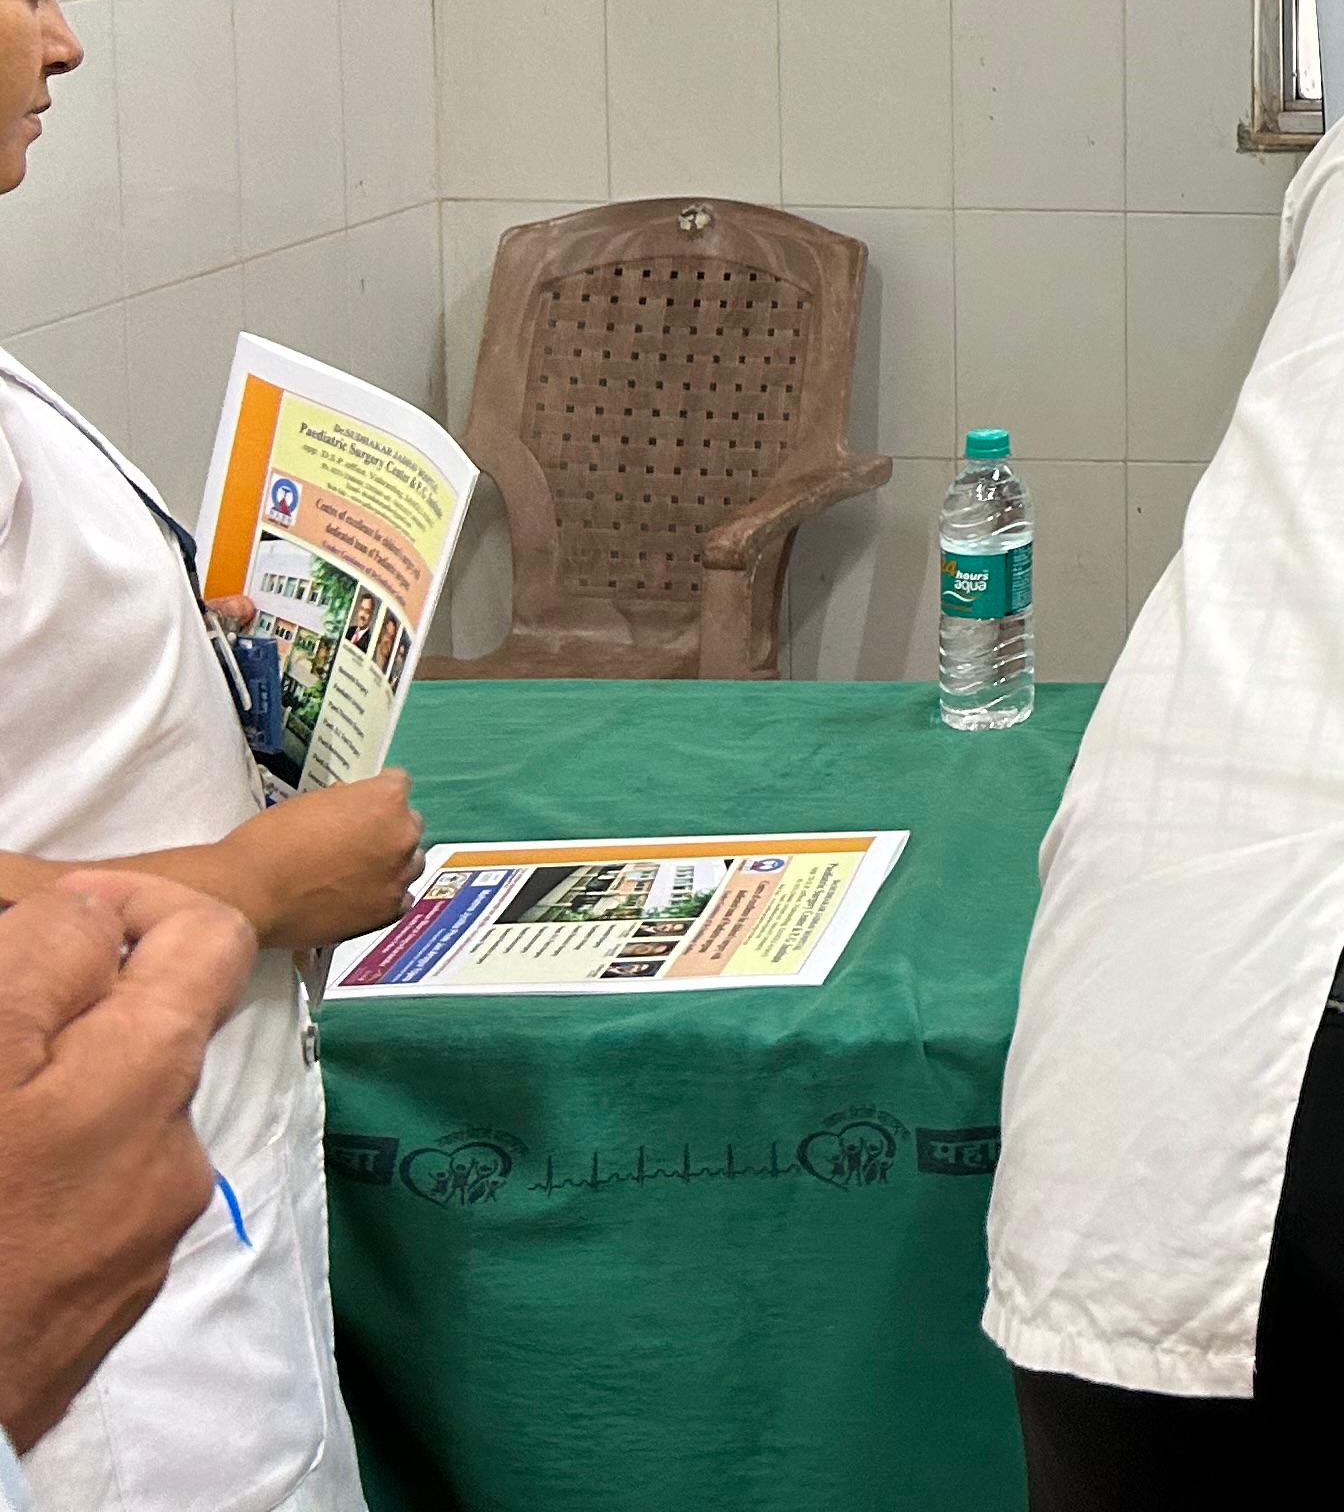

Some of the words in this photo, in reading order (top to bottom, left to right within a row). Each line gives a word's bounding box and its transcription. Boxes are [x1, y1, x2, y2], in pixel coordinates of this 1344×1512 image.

[350, 443, 384, 472] Surgery
[955, 570, 989, 581] hours
[954, 580, 987, 594] aqua
